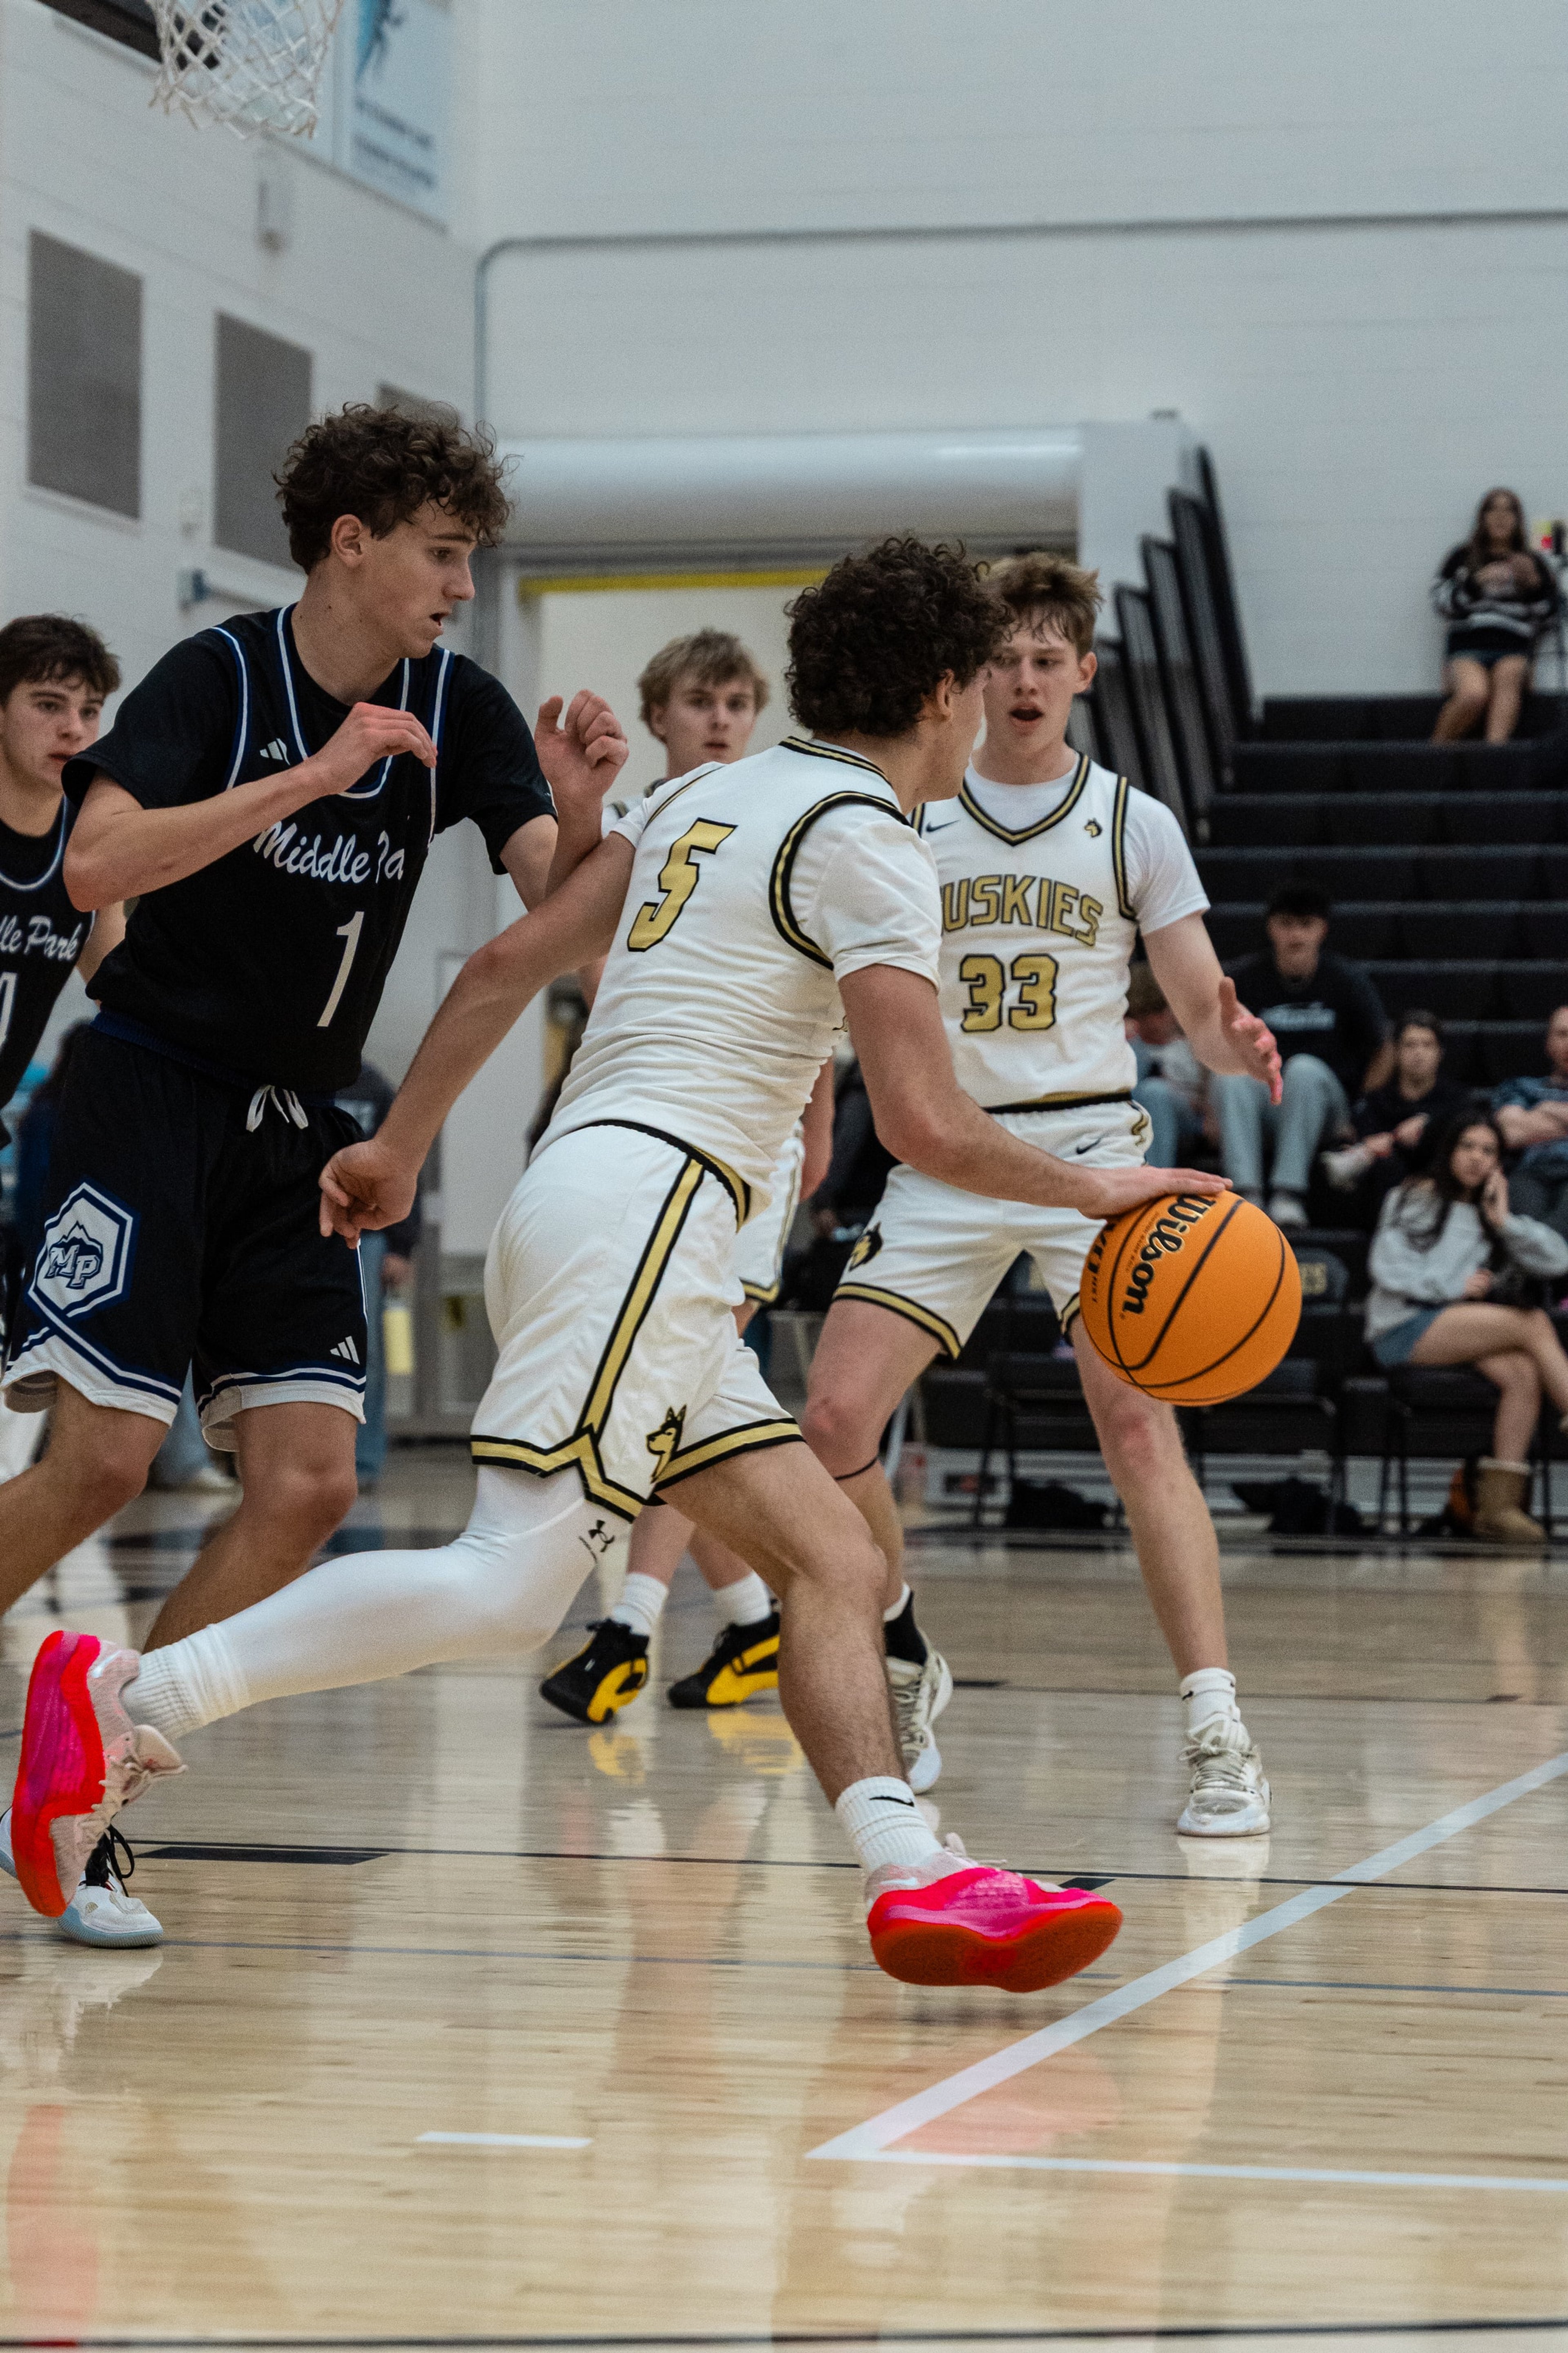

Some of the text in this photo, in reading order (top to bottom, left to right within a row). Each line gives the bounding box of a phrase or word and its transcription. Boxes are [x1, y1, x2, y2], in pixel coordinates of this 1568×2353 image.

[253, 821, 371, 883] Middle
[627, 817, 738, 952] 5
[23, 915, 82, 961] Park
[940, 874, 1103, 947] USKIES
[317, 911, 365, 1027] 1
[960, 953, 1059, 1033] 33
[1122, 1193, 1216, 1314] Wilson
